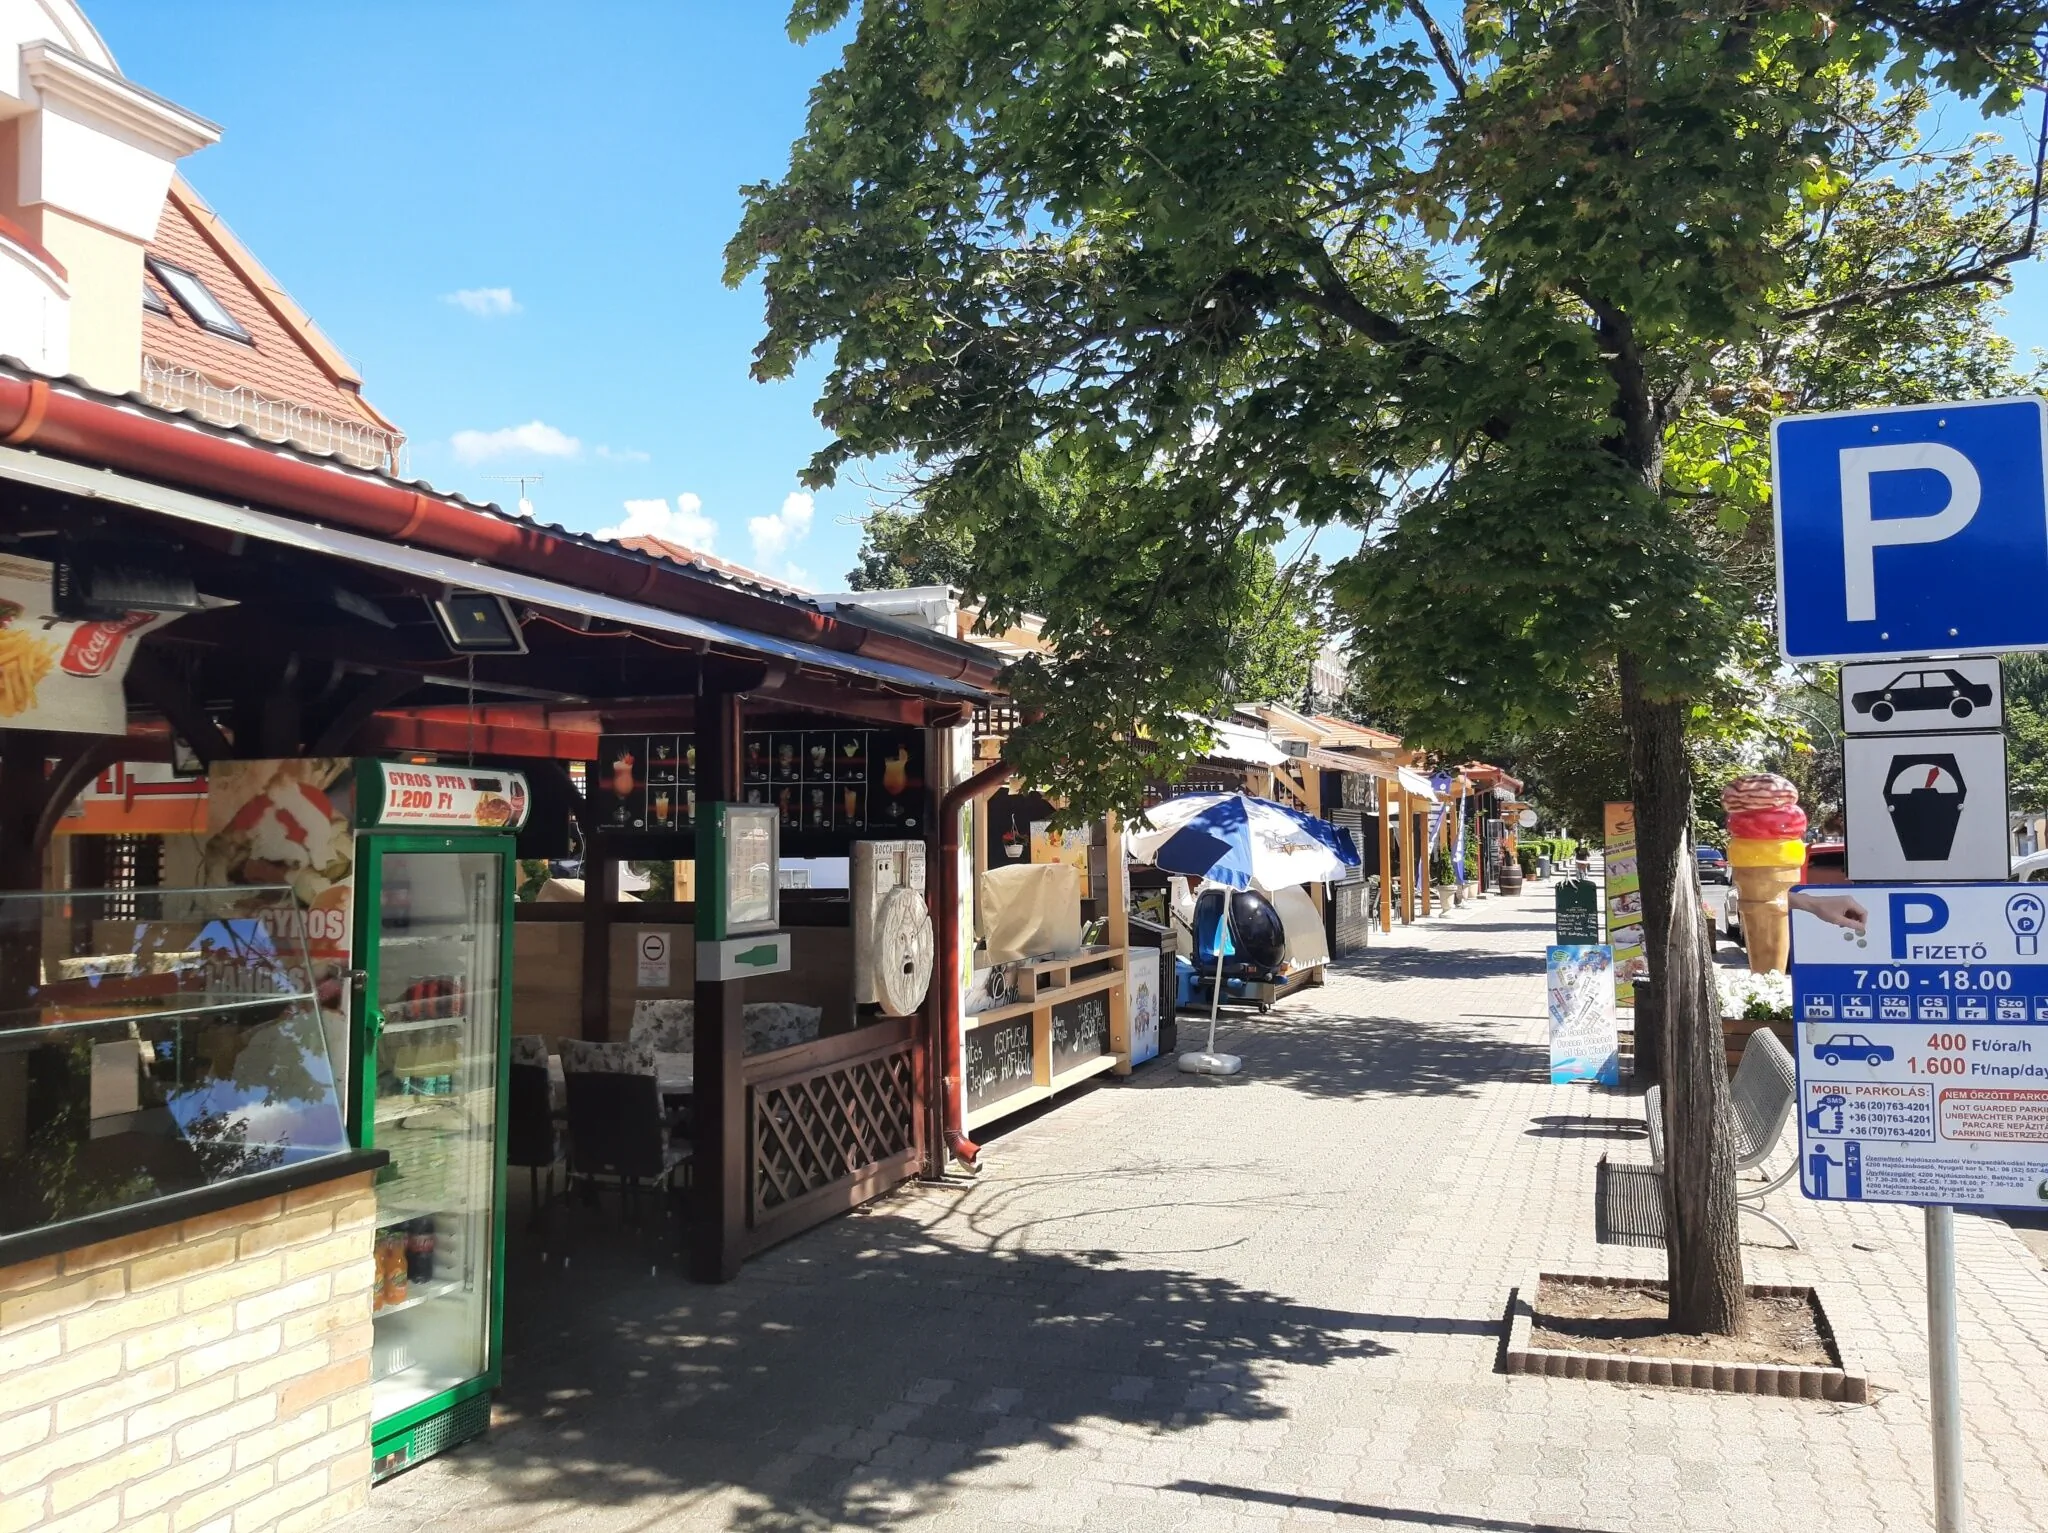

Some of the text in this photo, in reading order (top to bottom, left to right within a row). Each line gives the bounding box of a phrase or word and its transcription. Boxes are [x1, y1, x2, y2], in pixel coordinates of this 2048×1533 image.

[1839, 442, 1981, 621] P
[388, 771, 432, 787] GYROS
[435, 775, 466, 790] PITA
[389, 789, 453, 809] 1.200 Ft
[259, 908, 344, 940] GYROS
[1888, 892, 1987, 960] P FIZETŐ
[1853, 969, 1910, 990] 7.00
[1938, 970, 2012, 990] 18.00
[1813, 996, 2024, 1008] H K SZe CS P Szo
[1808, 1008, 2021, 1018] Mo Tu We Th Fr Sa
[1927, 1033, 2032, 1052] 400 Ft/óra/h
[1907, 1056, 2048, 1079] 1.600 Ft/nap/day
[1811, 1085, 1930, 1097] MOBIL PARKOLÁS:
[1945, 1091, 1967, 1099] NEM
[1945, 1113, 2013, 1121] UNBEWACHTER
[1962, 1121, 2005, 1129] PARCARE
